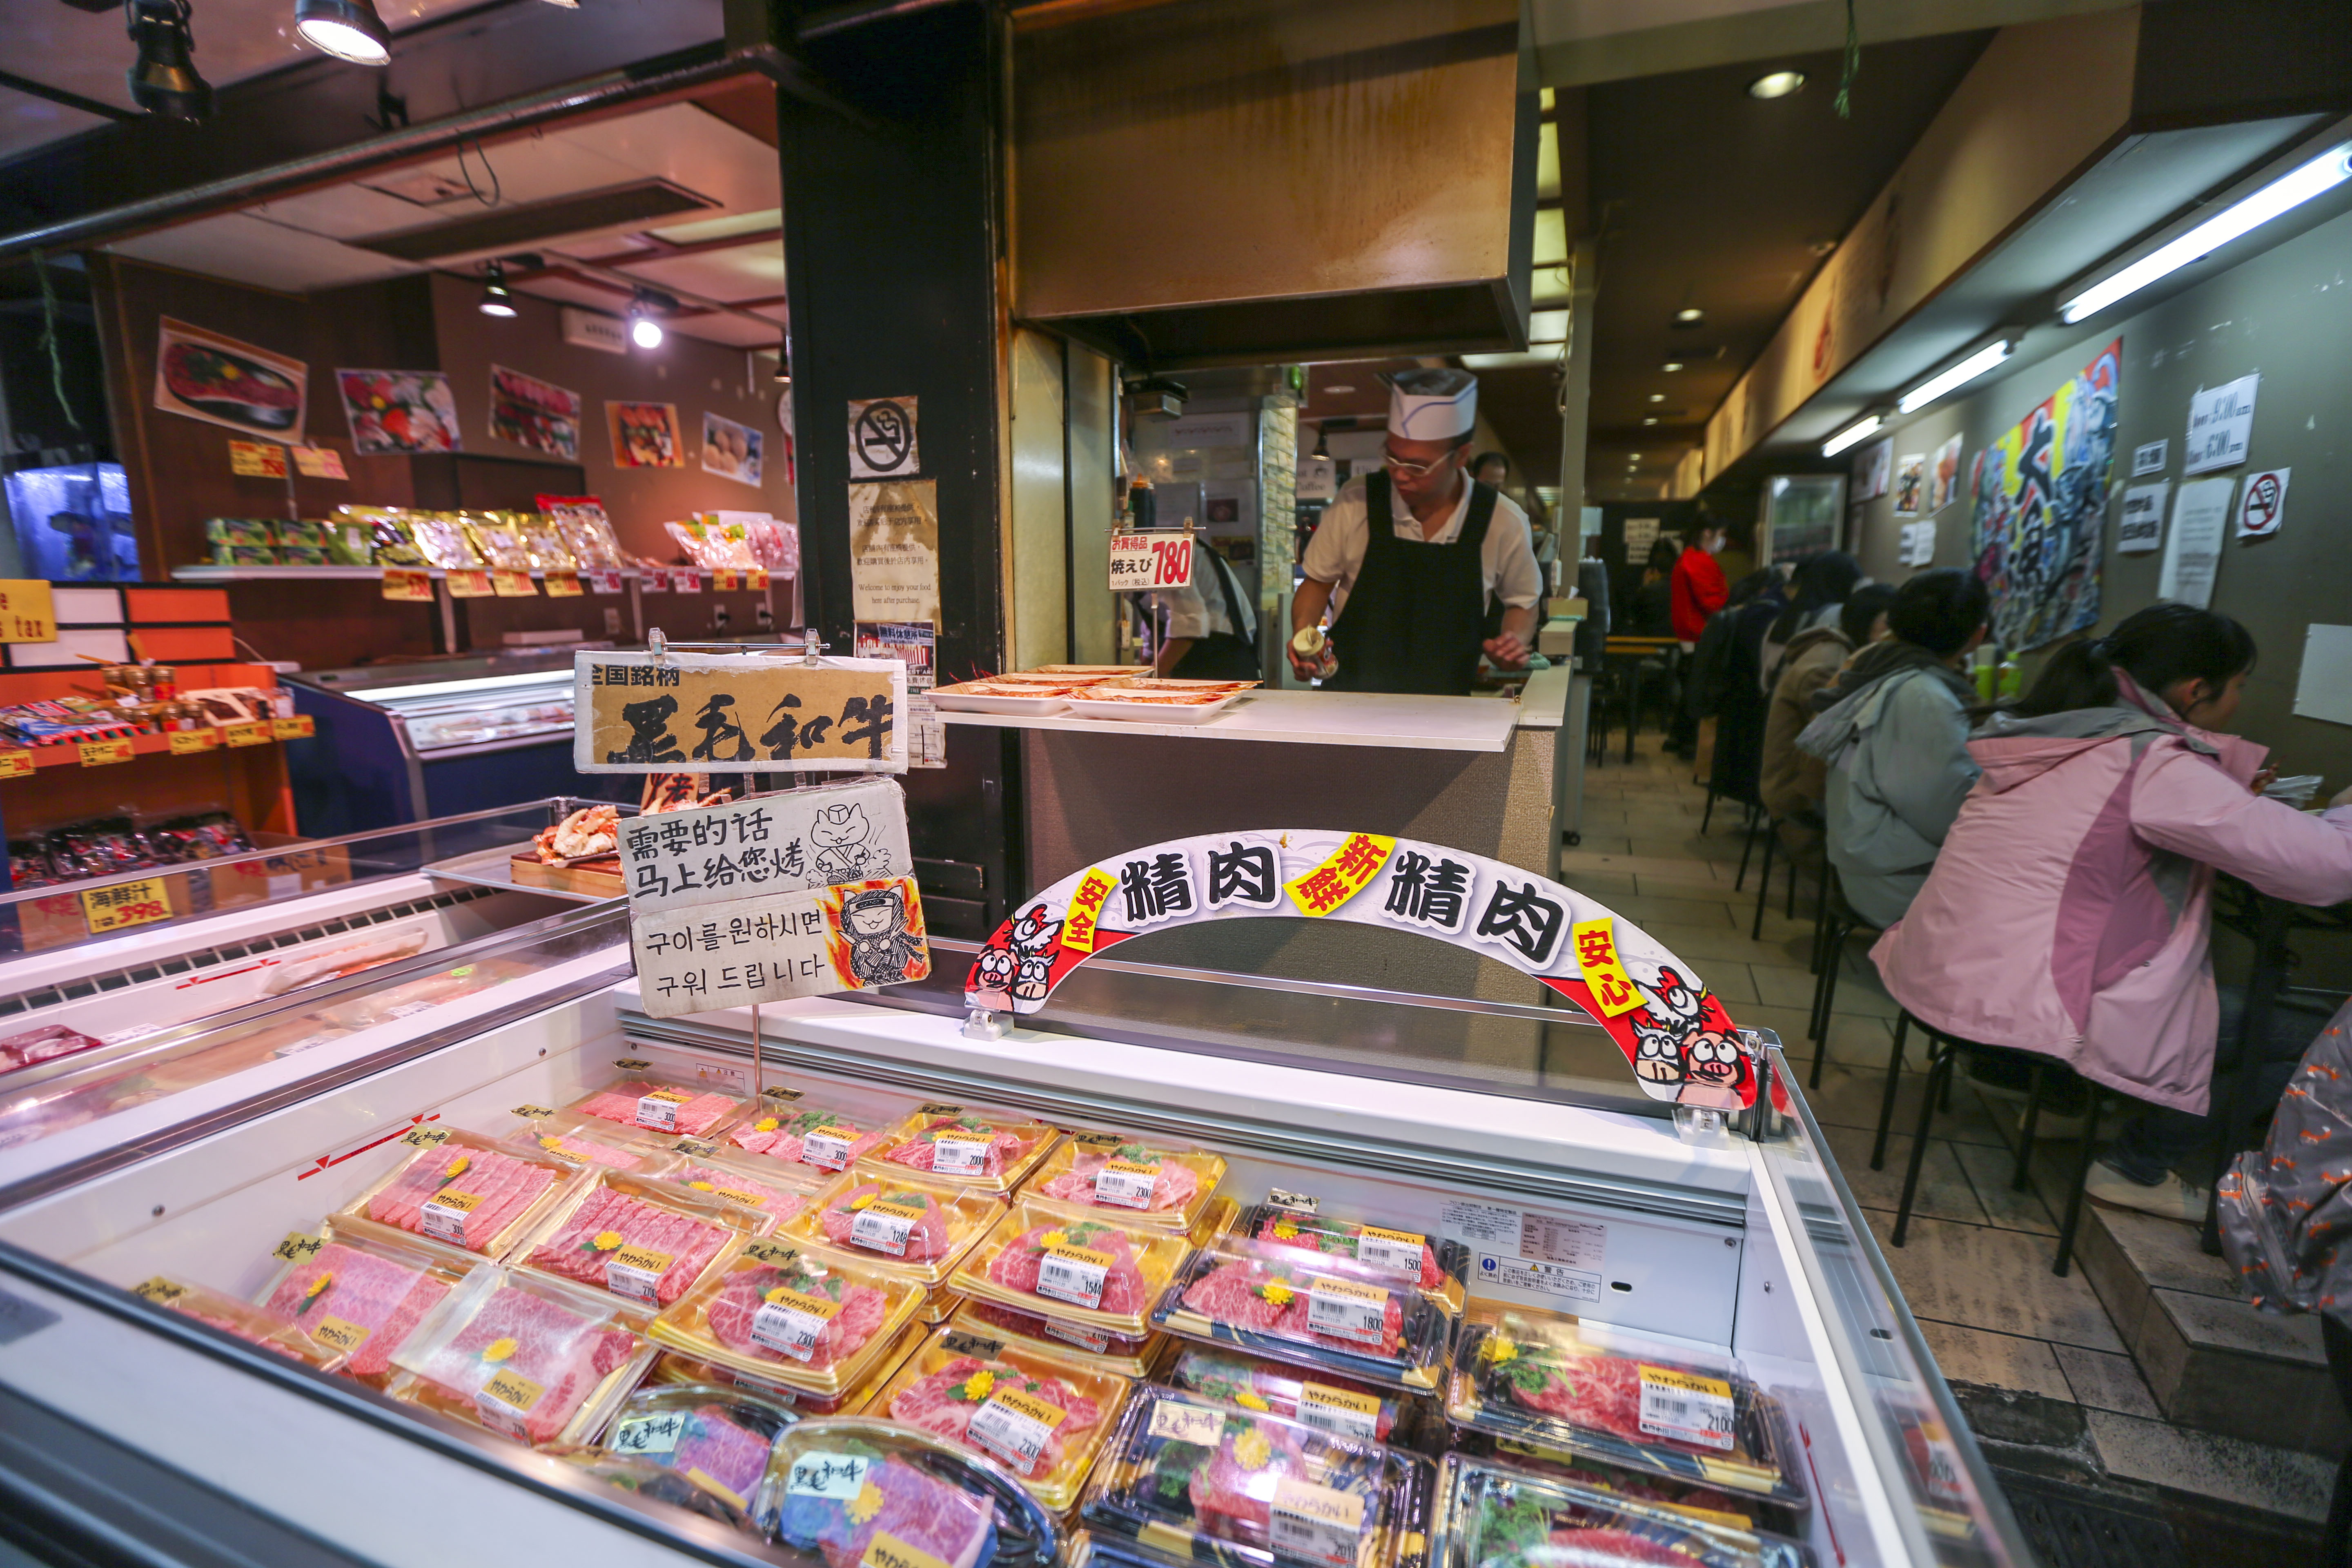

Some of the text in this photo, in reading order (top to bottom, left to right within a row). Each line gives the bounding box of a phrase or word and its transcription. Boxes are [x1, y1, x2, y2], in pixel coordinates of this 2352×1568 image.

[1112, 536, 1147, 550] お買得品
[1111, 558, 1153, 574] 焼えび
[1152, 540, 1191, 584] 780
[15, 615, 44, 638] tax
[879, 626, 918, 640] 無料休憩所
[606, 693, 893, 764] 黒毛和牛
[628, 807, 773, 860] 需要的话
[635, 839, 805, 898] 马上给您烤
[1295, 834, 1387, 912] 新鮮
[1121, 841, 1276, 922] 精肉
[89, 882, 153, 909] 海鮮汁
[116, 900, 164, 924] 398
[1065, 876, 1108, 944] 安全
[1385, 851, 1564, 964] 精肉
[657, 954, 825, 997] 구워 드립니다
[1578, 929, 1634, 1007] 安心
[664, 1112, 675, 1123] 3000
[818, 1129, 852, 1140] やわらかい
[835, 1150, 847, 1162] 3000
[970, 1155, 983, 1166] 2000
[1111, 1165, 1152, 1174] やわらかい
[1136, 1186, 1152, 1199] 2300
[437, 1195, 472, 1209] やわらかい
[873, 1205, 914, 1218] やわらかい
[893, 1230, 907, 1245] 1248
[1368, 1231, 1414, 1243] やわらかい
[620, 1252, 661, 1269] やわらかい
[1056, 1248, 1103, 1264] やわらかい
[1405, 1258, 1421, 1272] 1500
[1544, 1266, 1564, 1276] 警告
[1085, 1281, 1101, 1297] 1544
[1321, 1283, 1376, 1299] やわらかい
[780, 1296, 827, 1315] やわらかい
[1364, 1315, 1383, 1331] 1800
[318, 1325, 356, 1346] やわらかい
[797, 1331, 815, 1349] 2300
[490, 1379, 530, 1404] やわらかい
[1648, 1373, 1718, 1394] やわらかい
[1002, 1394, 1051, 1422] やわらかい
[1309, 1391, 1367, 1411] やわらかい
[1708, 1414, 1734, 1434] 2100
[1018, 1438, 1040, 1461] 2300
